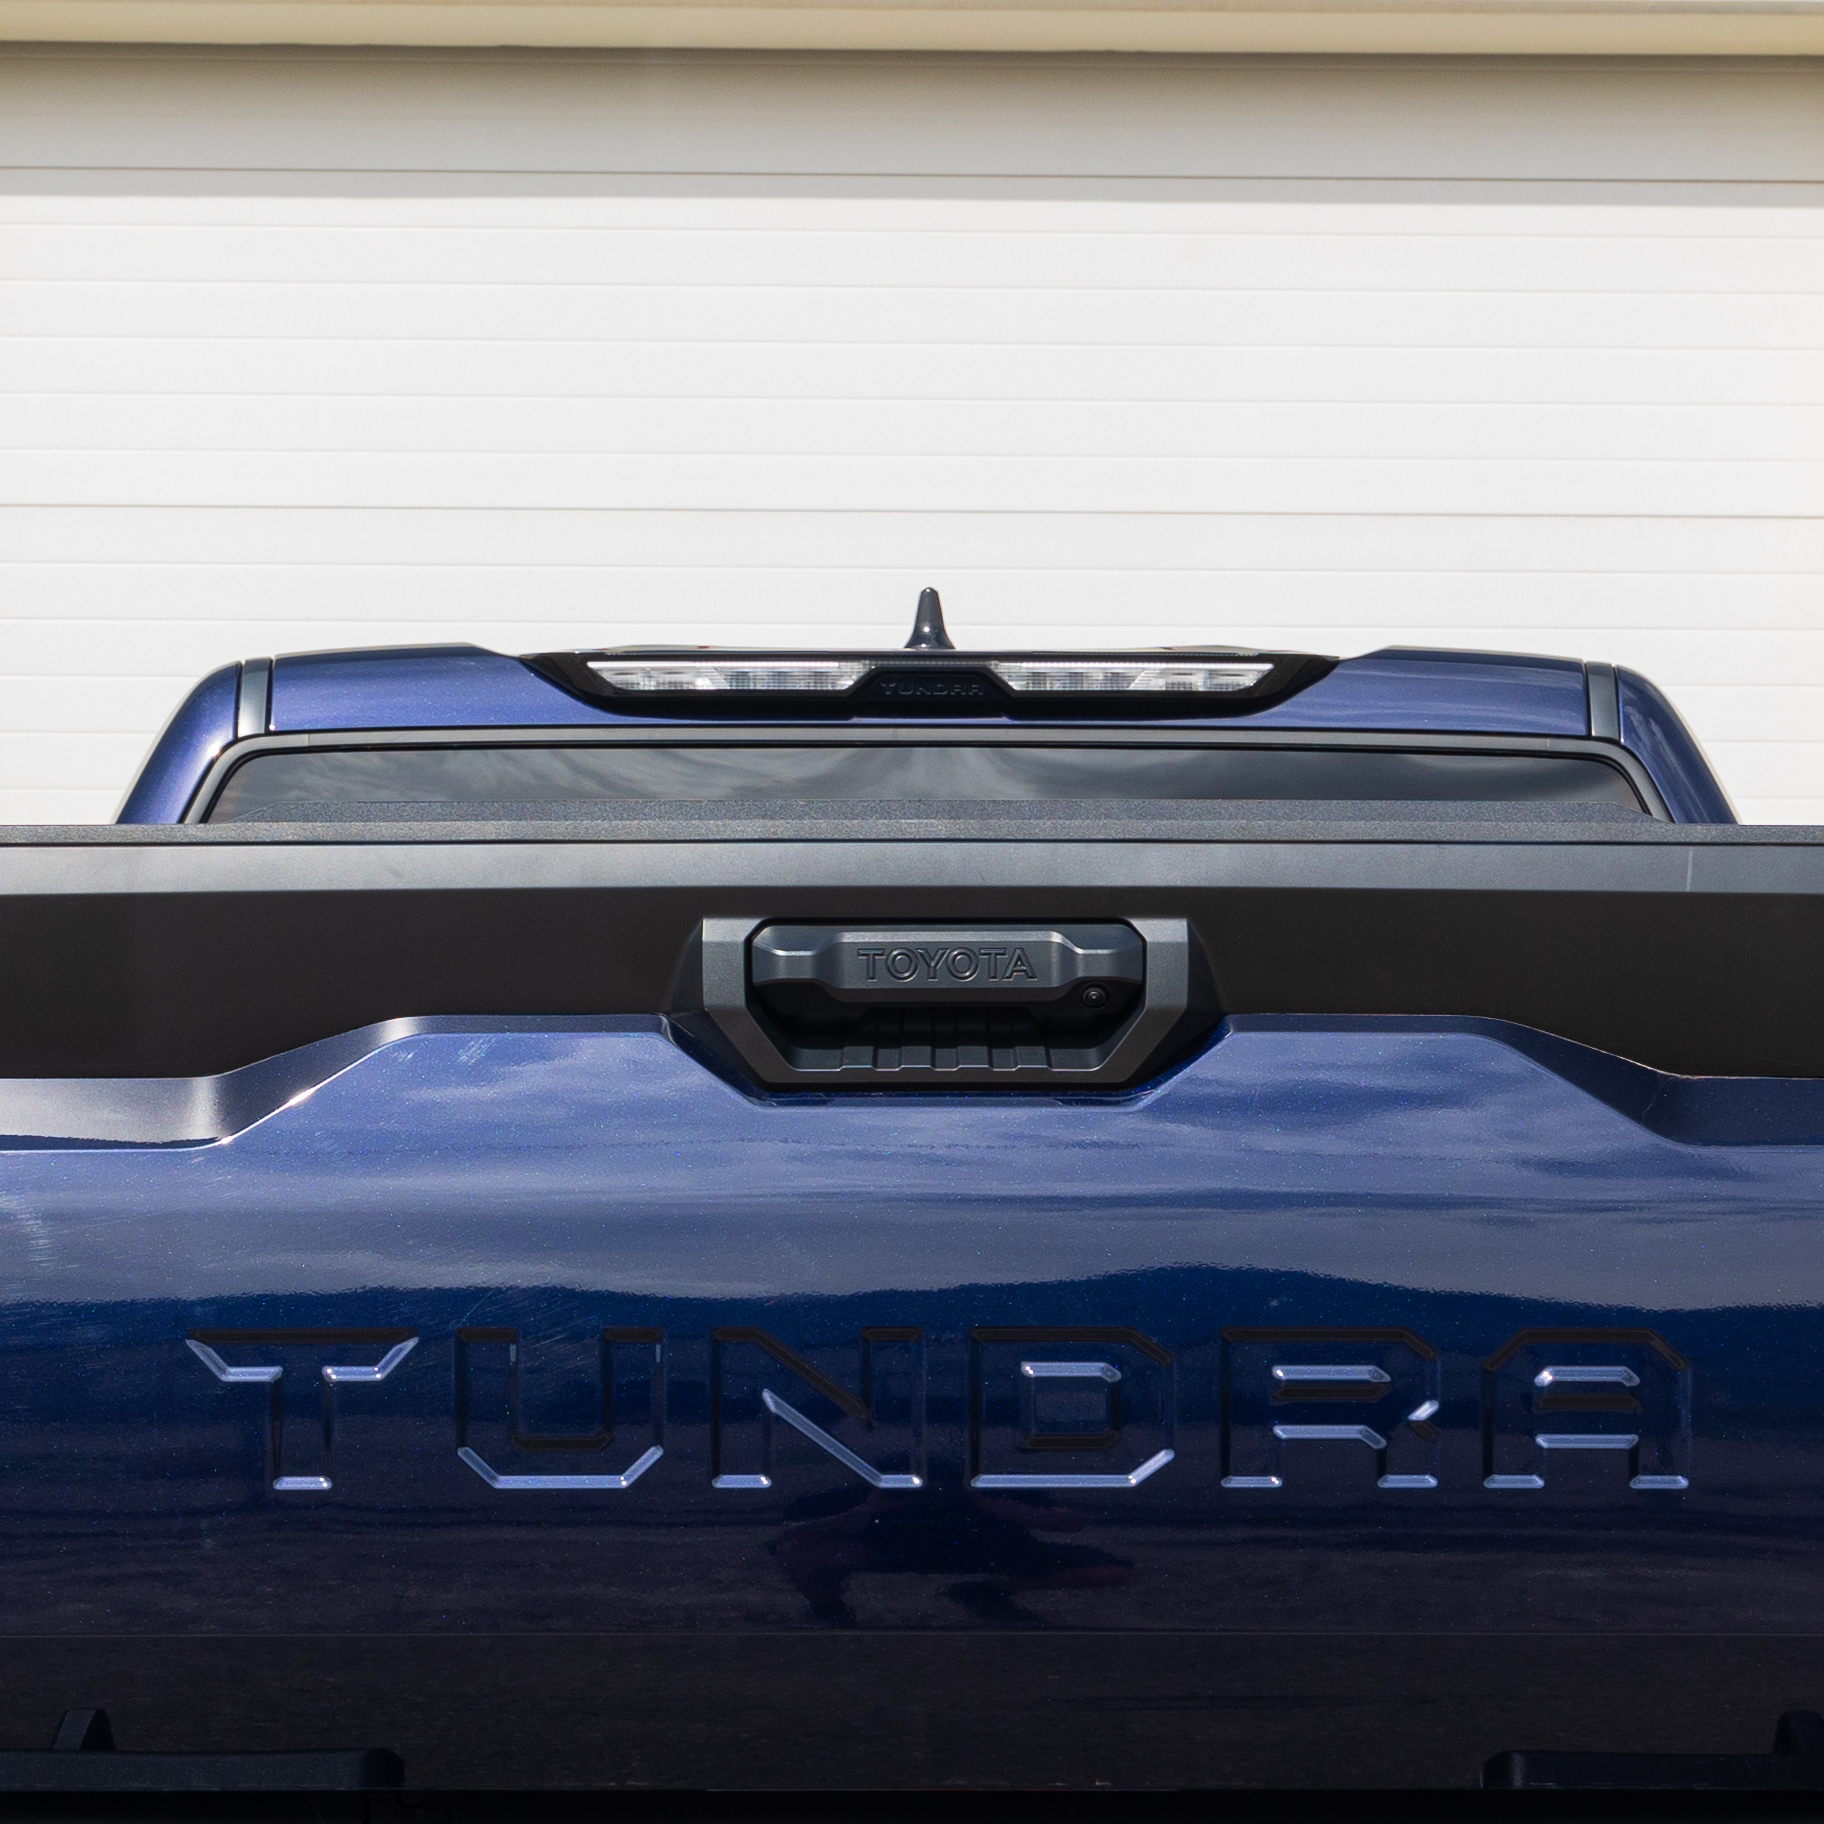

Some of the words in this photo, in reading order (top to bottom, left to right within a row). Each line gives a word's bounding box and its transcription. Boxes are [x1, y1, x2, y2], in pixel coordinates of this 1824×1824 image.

[879, 681, 984, 695] TUNDRA
[856, 946, 1038, 983] TOYOTA
[185, 1326, 1692, 1489] TUNDRA
